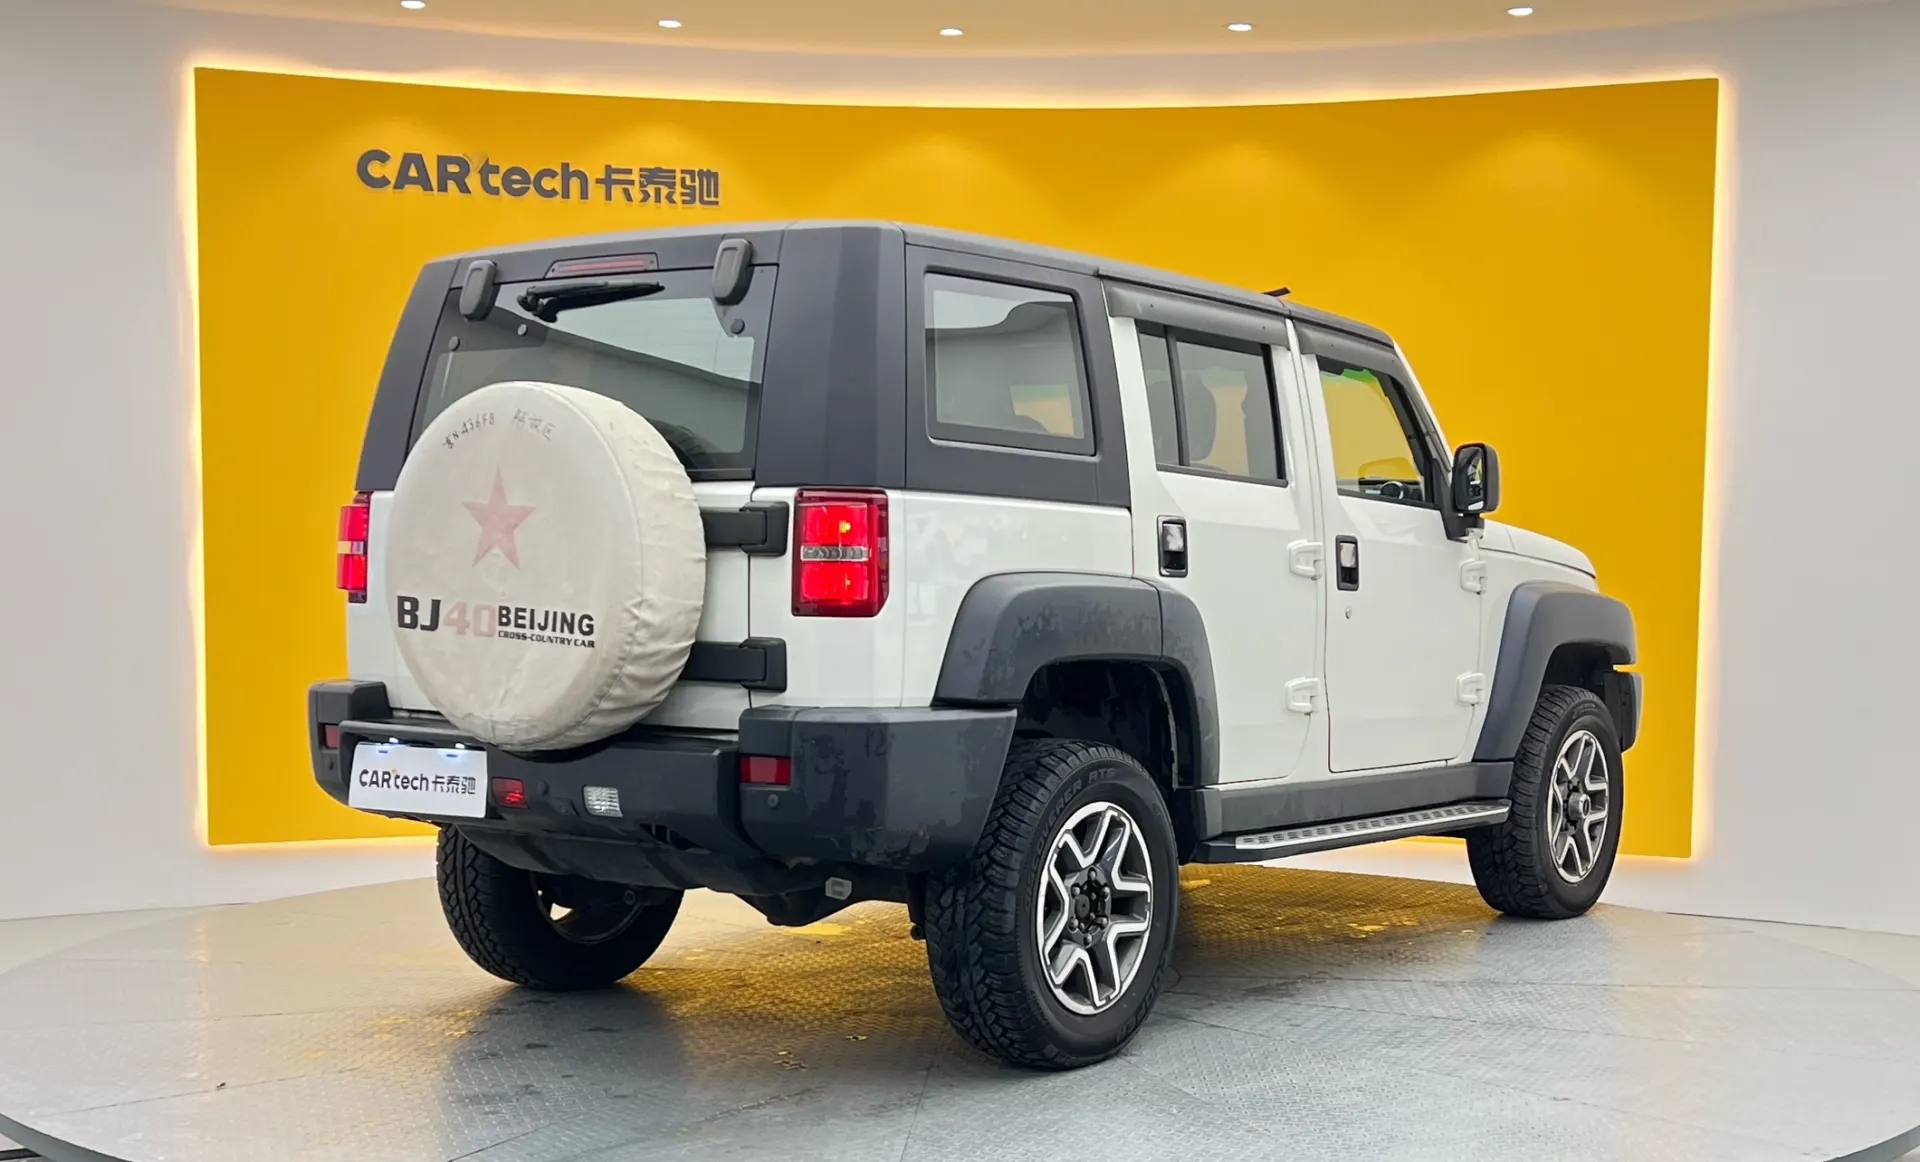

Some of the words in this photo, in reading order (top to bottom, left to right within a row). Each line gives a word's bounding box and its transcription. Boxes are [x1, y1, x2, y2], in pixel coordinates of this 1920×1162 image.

[356, 148, 589, 200] CARtech
[595, 163, 720, 207] 卡泰驰
[498, 605, 594, 636] BEIJING
[498, 630, 573, 646] CROSS-COUNTRY
[573, 638, 596, 648] CAR
[359, 768, 429, 792] CARtech
[431, 774, 476, 795] 卡泰驰
